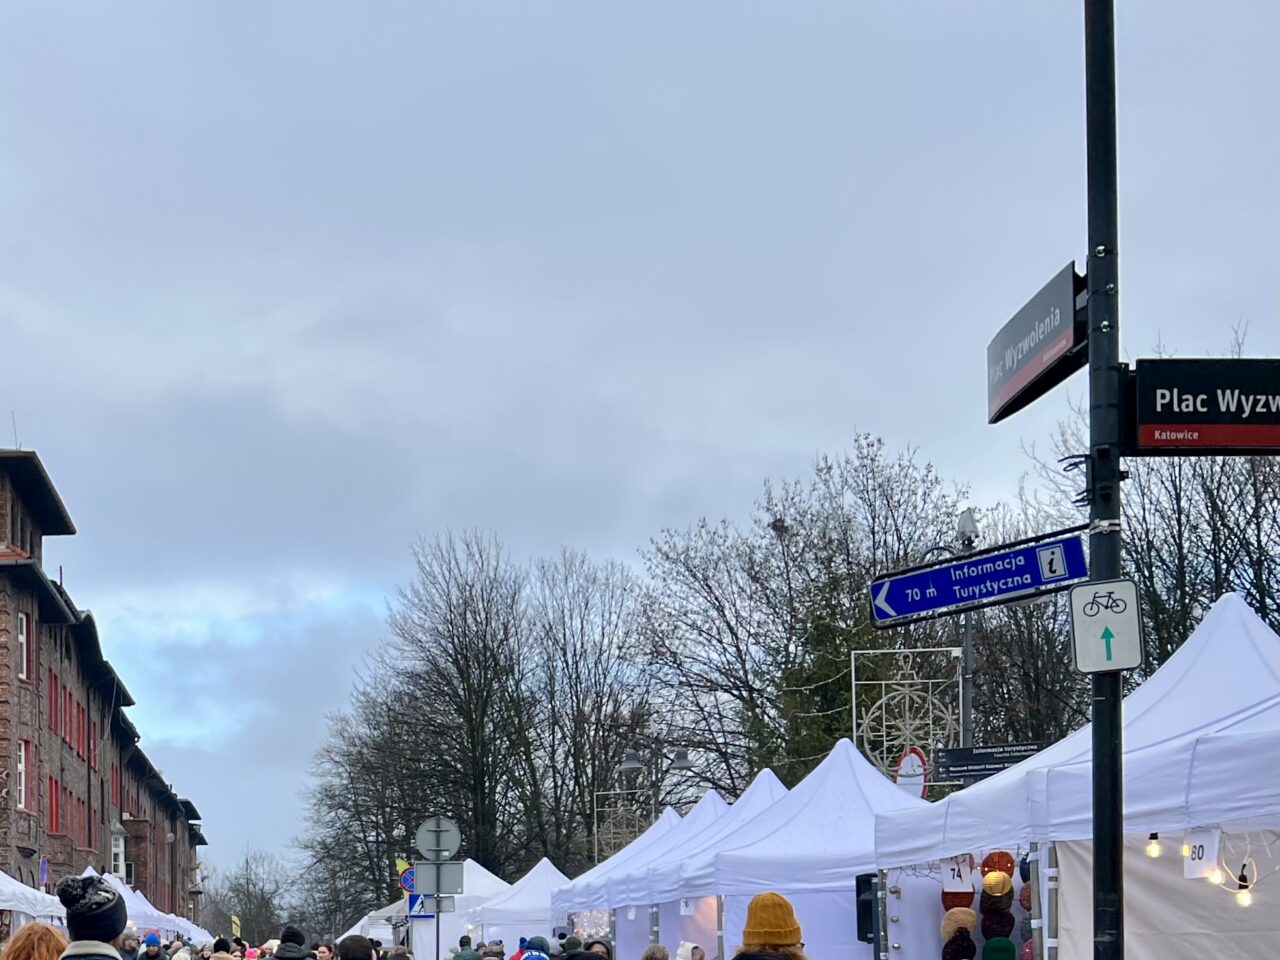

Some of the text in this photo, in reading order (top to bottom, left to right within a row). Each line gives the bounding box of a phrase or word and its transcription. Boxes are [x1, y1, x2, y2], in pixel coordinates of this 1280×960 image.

[1005, 306, 1061, 371] Wyzwolenia
[1155, 388, 1208, 412] Plac
[1154, 430, 1199, 440] Katowice
[950, 553, 1025, 581] Informacja
[905, 587, 937, 602] 70 m
[953, 573, 1032, 599] Turystyczna
[1191, 844, 1204, 861] 80
[950, 868, 962, 880] 74
